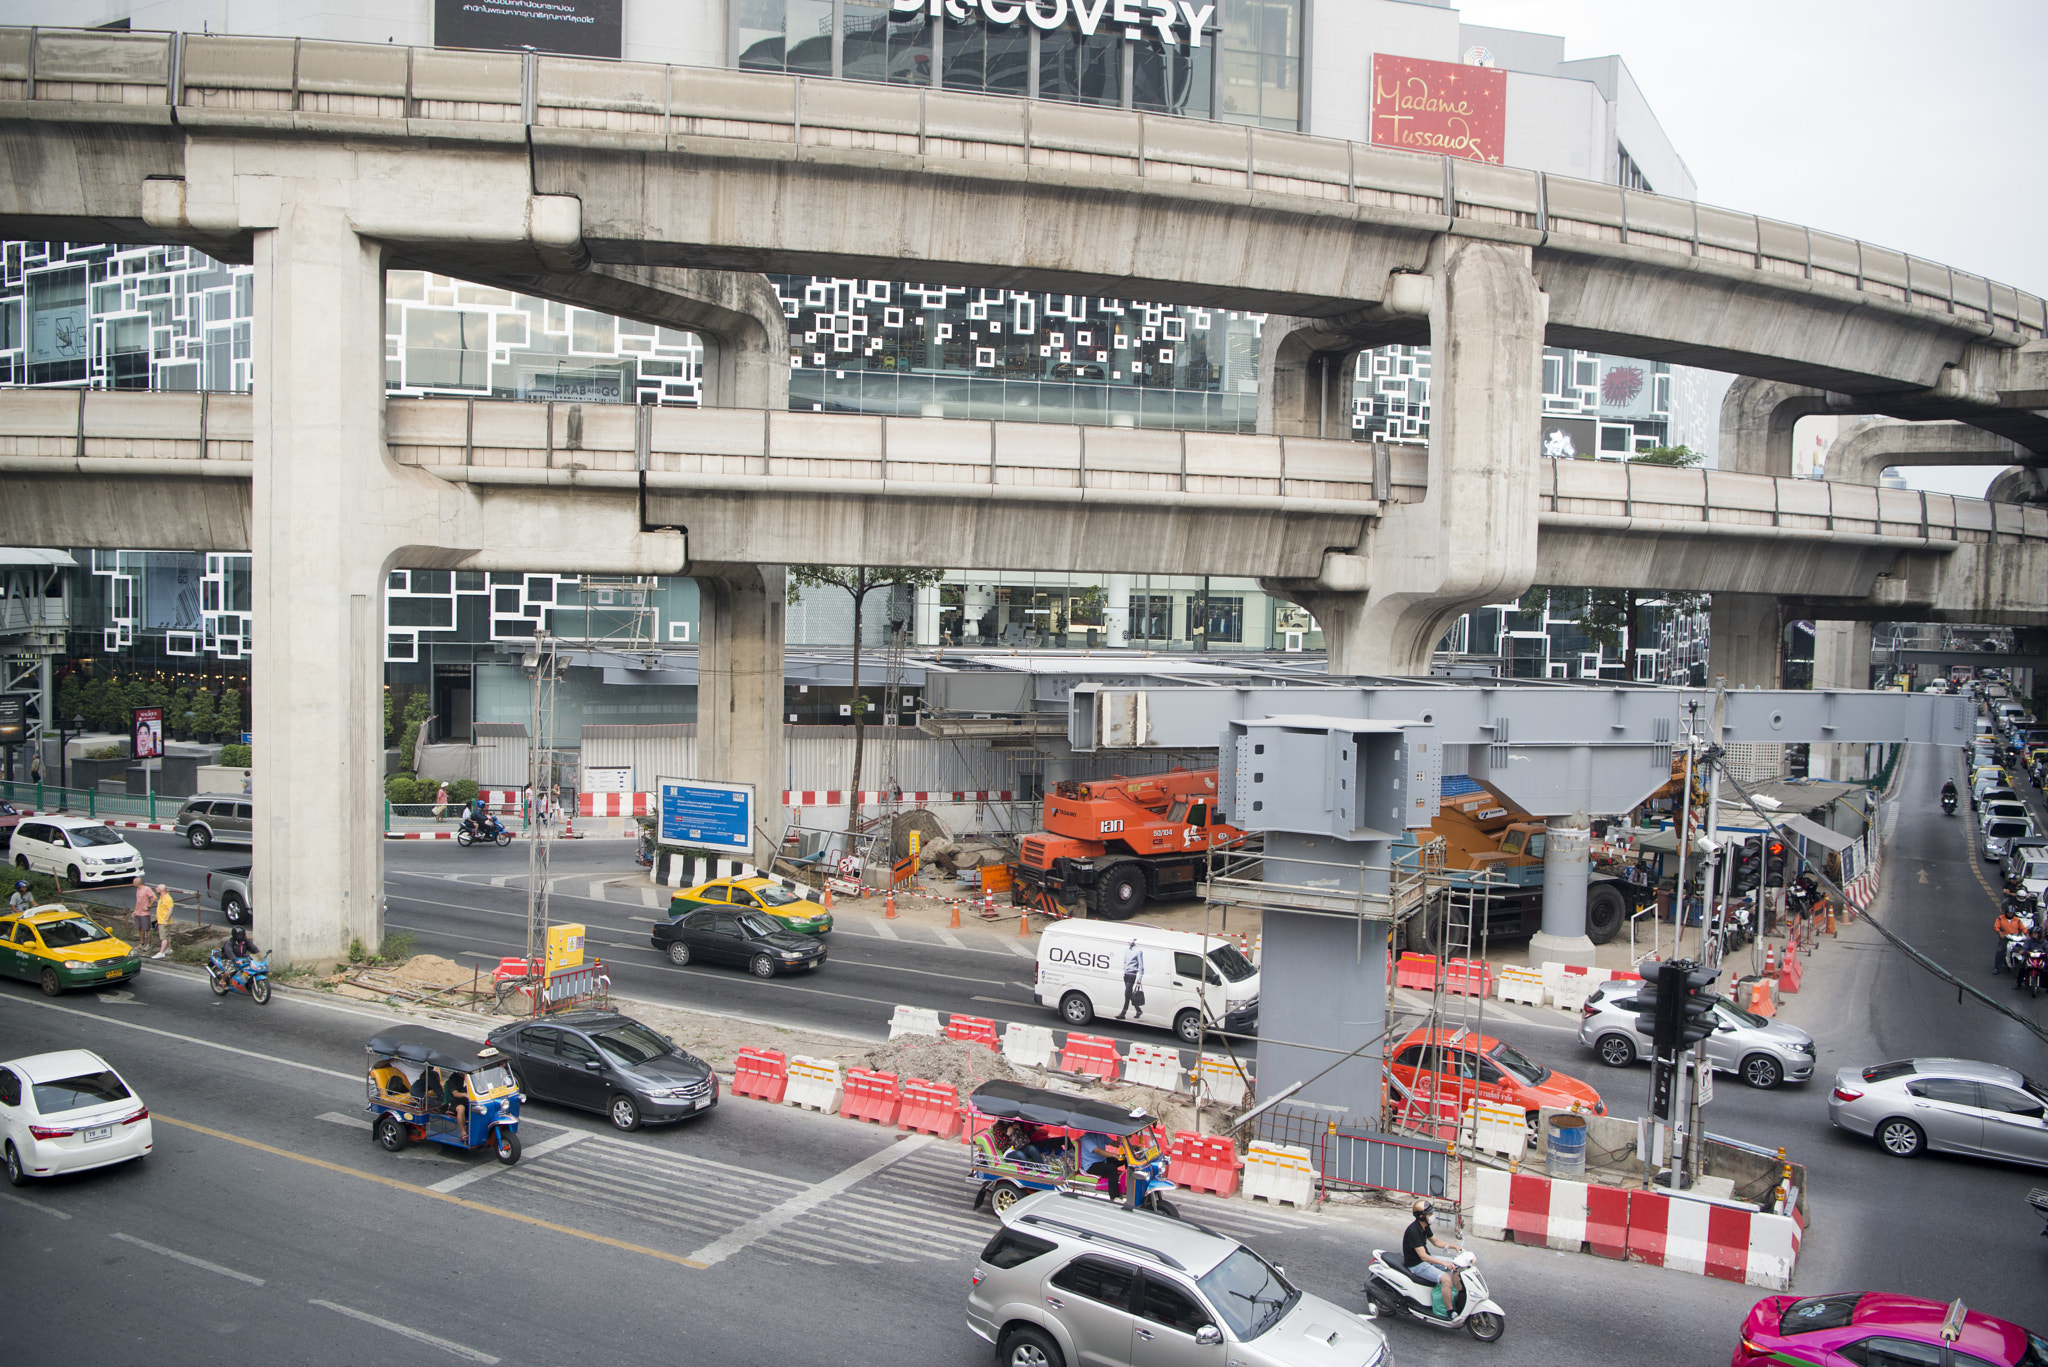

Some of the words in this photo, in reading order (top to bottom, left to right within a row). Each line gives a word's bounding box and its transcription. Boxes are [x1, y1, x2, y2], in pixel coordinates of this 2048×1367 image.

[891, 0, 1216, 48] COVERY
[1376, 74, 1474, 116] Madame
[1378, 115, 1486, 162] Tussauds
[555, 384, 586, 395] GRAB
[587, 386, 600, 394] AND
[601, 386, 619, 397] GO
[1049, 947, 1110, 970] OASIS
